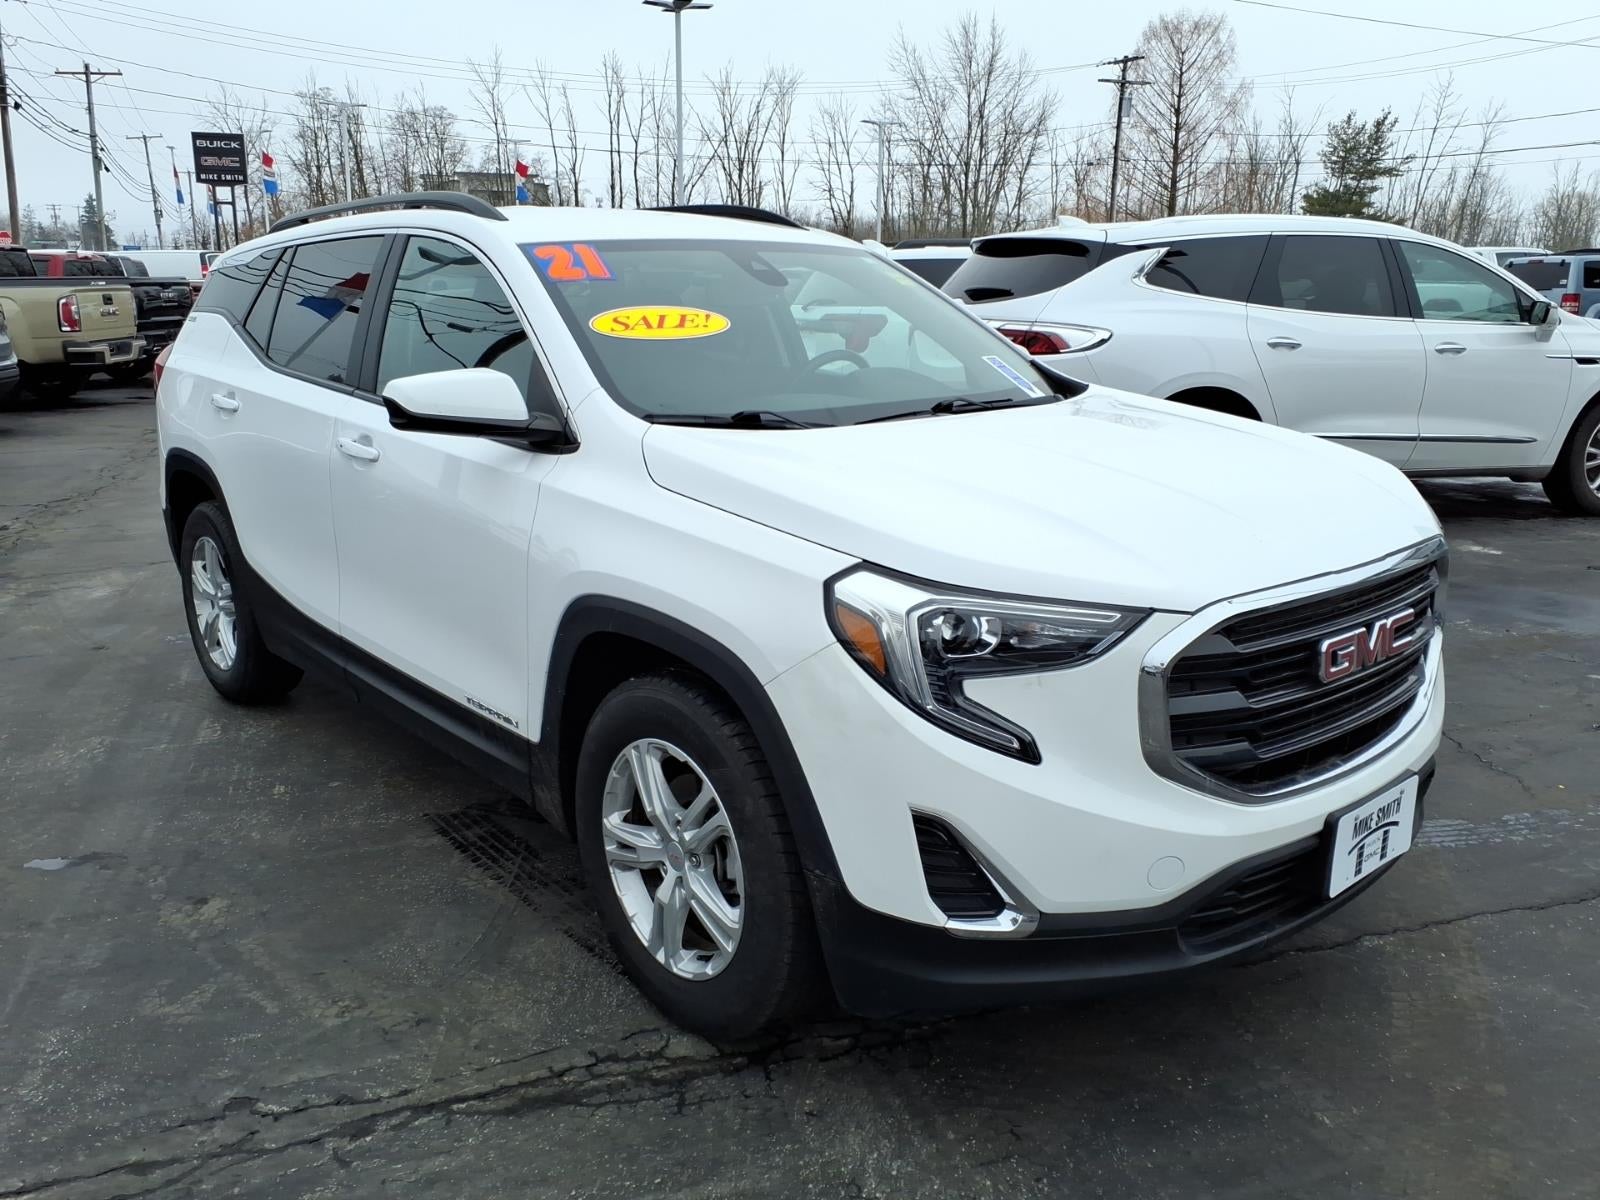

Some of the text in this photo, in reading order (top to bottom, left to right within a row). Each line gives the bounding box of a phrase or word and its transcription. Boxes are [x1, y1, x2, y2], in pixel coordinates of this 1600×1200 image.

[196, 140, 241, 149] BUICK
[200, 156, 240, 167] GMC
[200, 173, 218, 181] MIKE
[533, 243, 611, 282] 21
[610, 313, 711, 332] SALE!
[1319, 608, 1415, 684] GMC
[1352, 796, 1403, 841] MIKE SMITH
